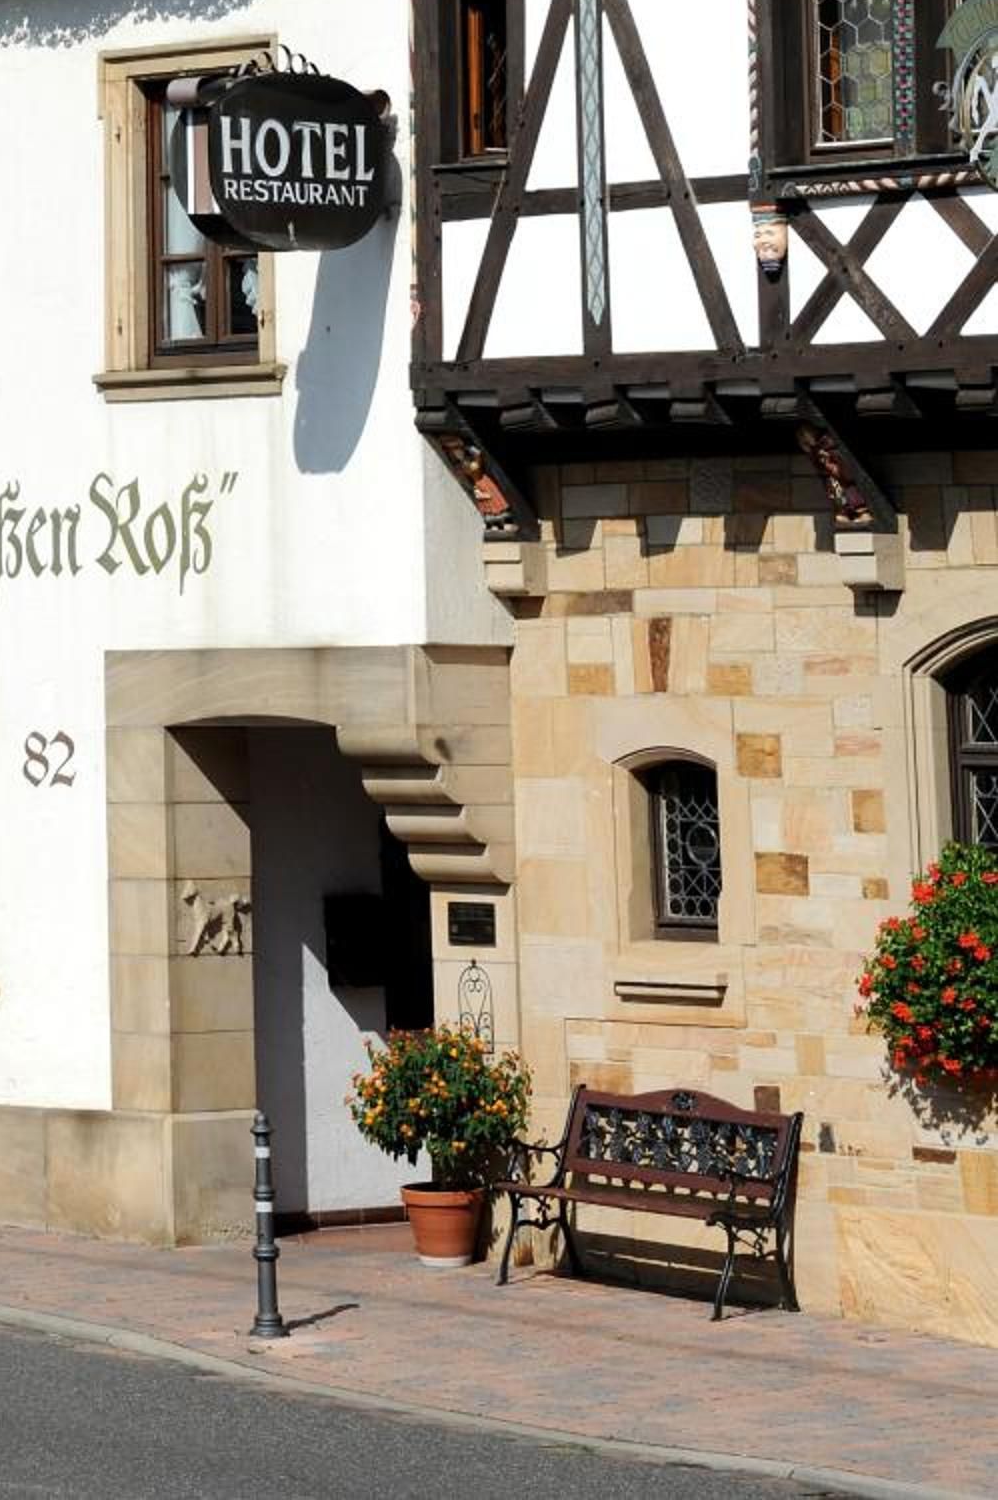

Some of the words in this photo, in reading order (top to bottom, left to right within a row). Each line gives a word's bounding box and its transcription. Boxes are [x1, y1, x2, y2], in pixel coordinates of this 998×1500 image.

[220, 115, 375, 182] HOTEL
[224, 178, 369, 207] RESTAURANT
[22, 730, 75, 788] 82
